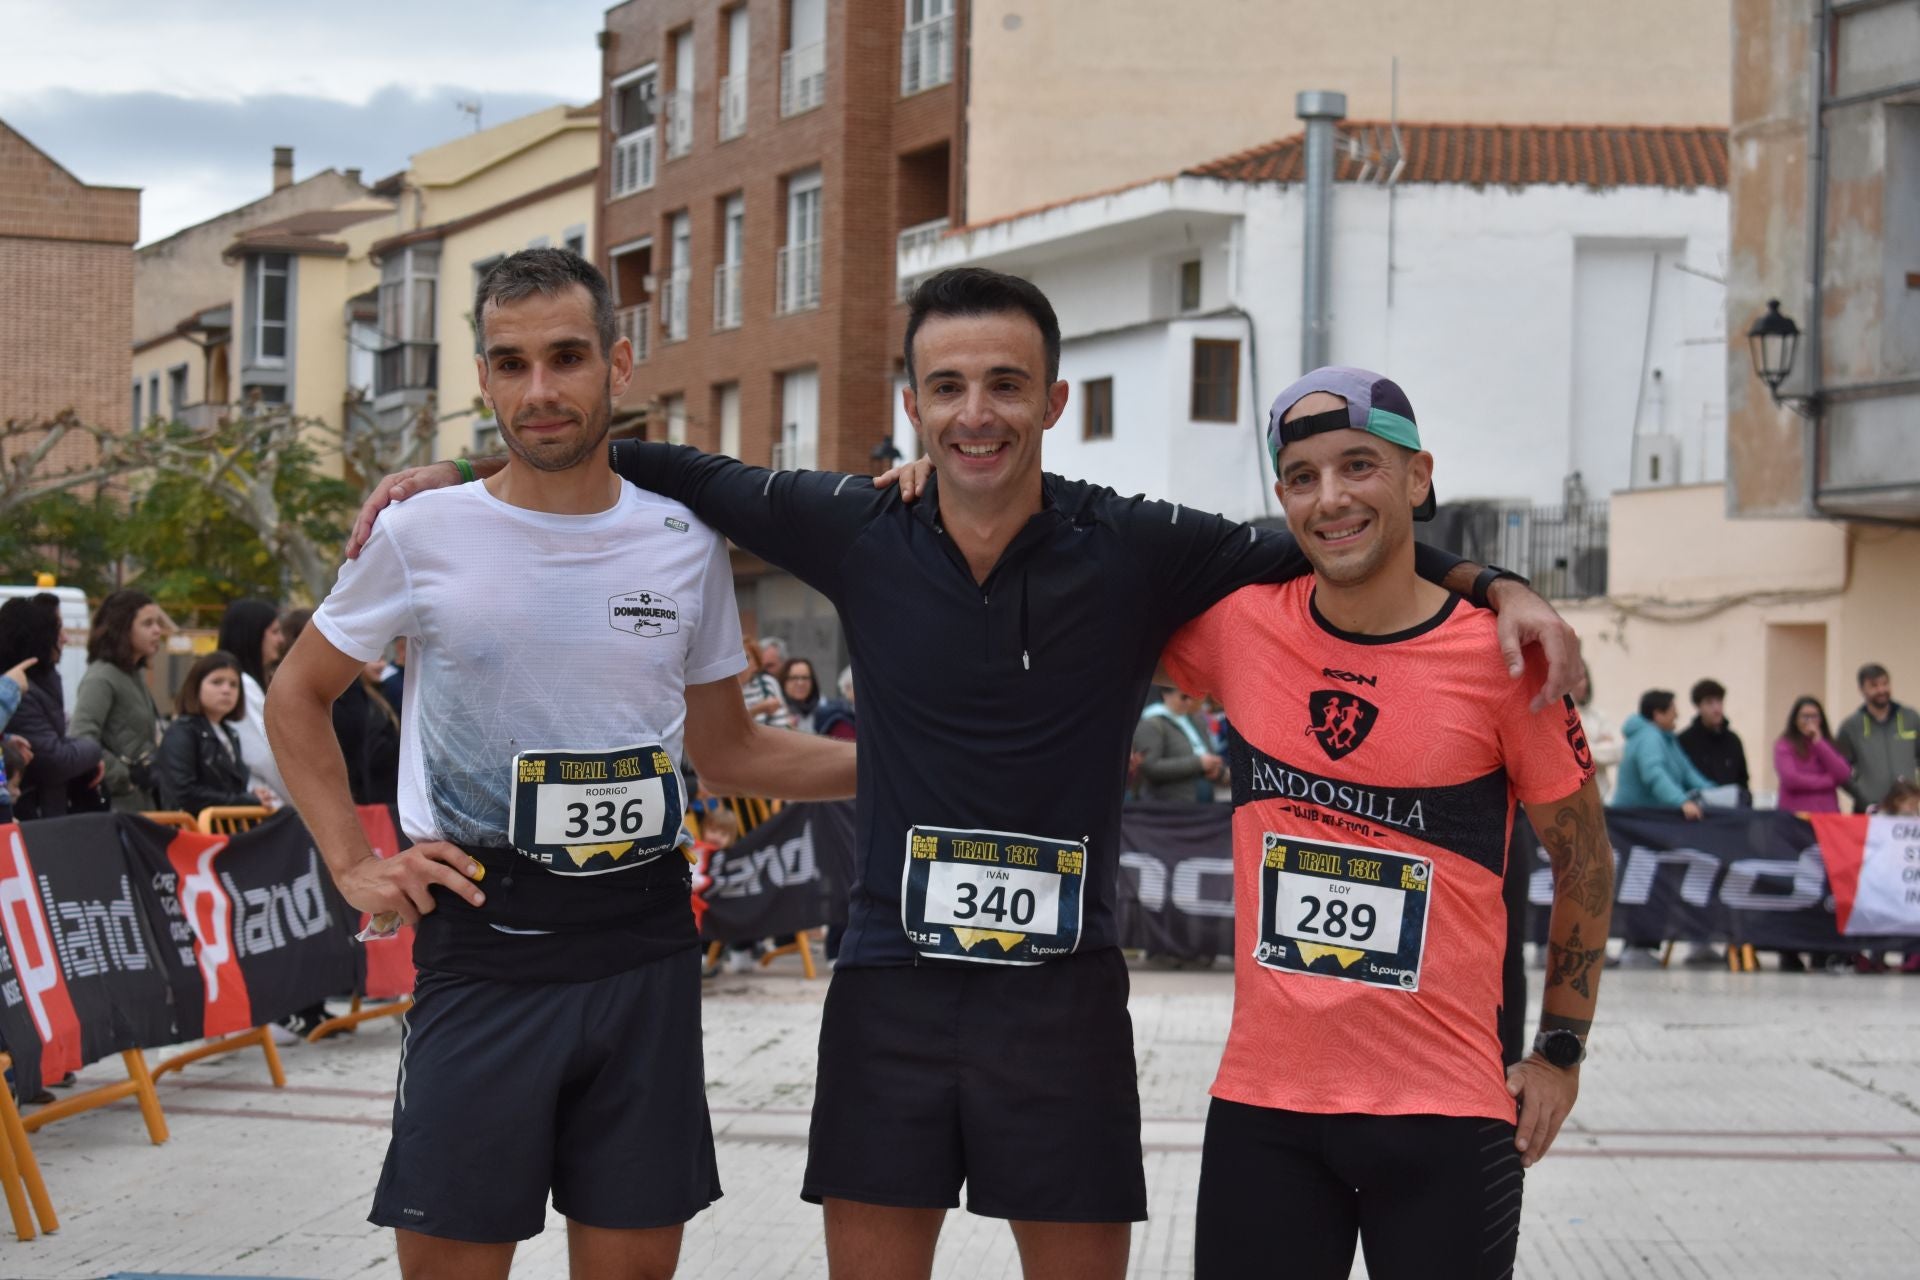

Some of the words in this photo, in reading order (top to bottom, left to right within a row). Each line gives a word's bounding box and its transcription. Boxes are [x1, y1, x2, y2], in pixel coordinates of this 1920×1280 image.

[614, 607, 676, 620] DOMINGUEROS
[560, 761, 607, 779] TRAIL
[613, 757, 641, 777] 13K
[586, 787, 628, 796] RODRIGO
[1252, 758, 1426, 831] ANDOSILLA
[565, 799, 643, 838] 336
[952, 839, 999, 861] TRAIL
[1005, 845, 1039, 865] 13K
[986, 870, 1010, 880] IVÁN
[1298, 851, 1342, 875] TRAIL
[1347, 858, 1382, 881] 13K
[1329, 884, 1351, 895] ELOY
[220, 847, 329, 959] land
[953, 882, 1036, 925] 340
[39, 874, 147, 980] land
[1296, 895, 1377, 942] 289
[1031, 944, 1068, 955] b.power
[1370, 962, 1400, 975] b.pow
